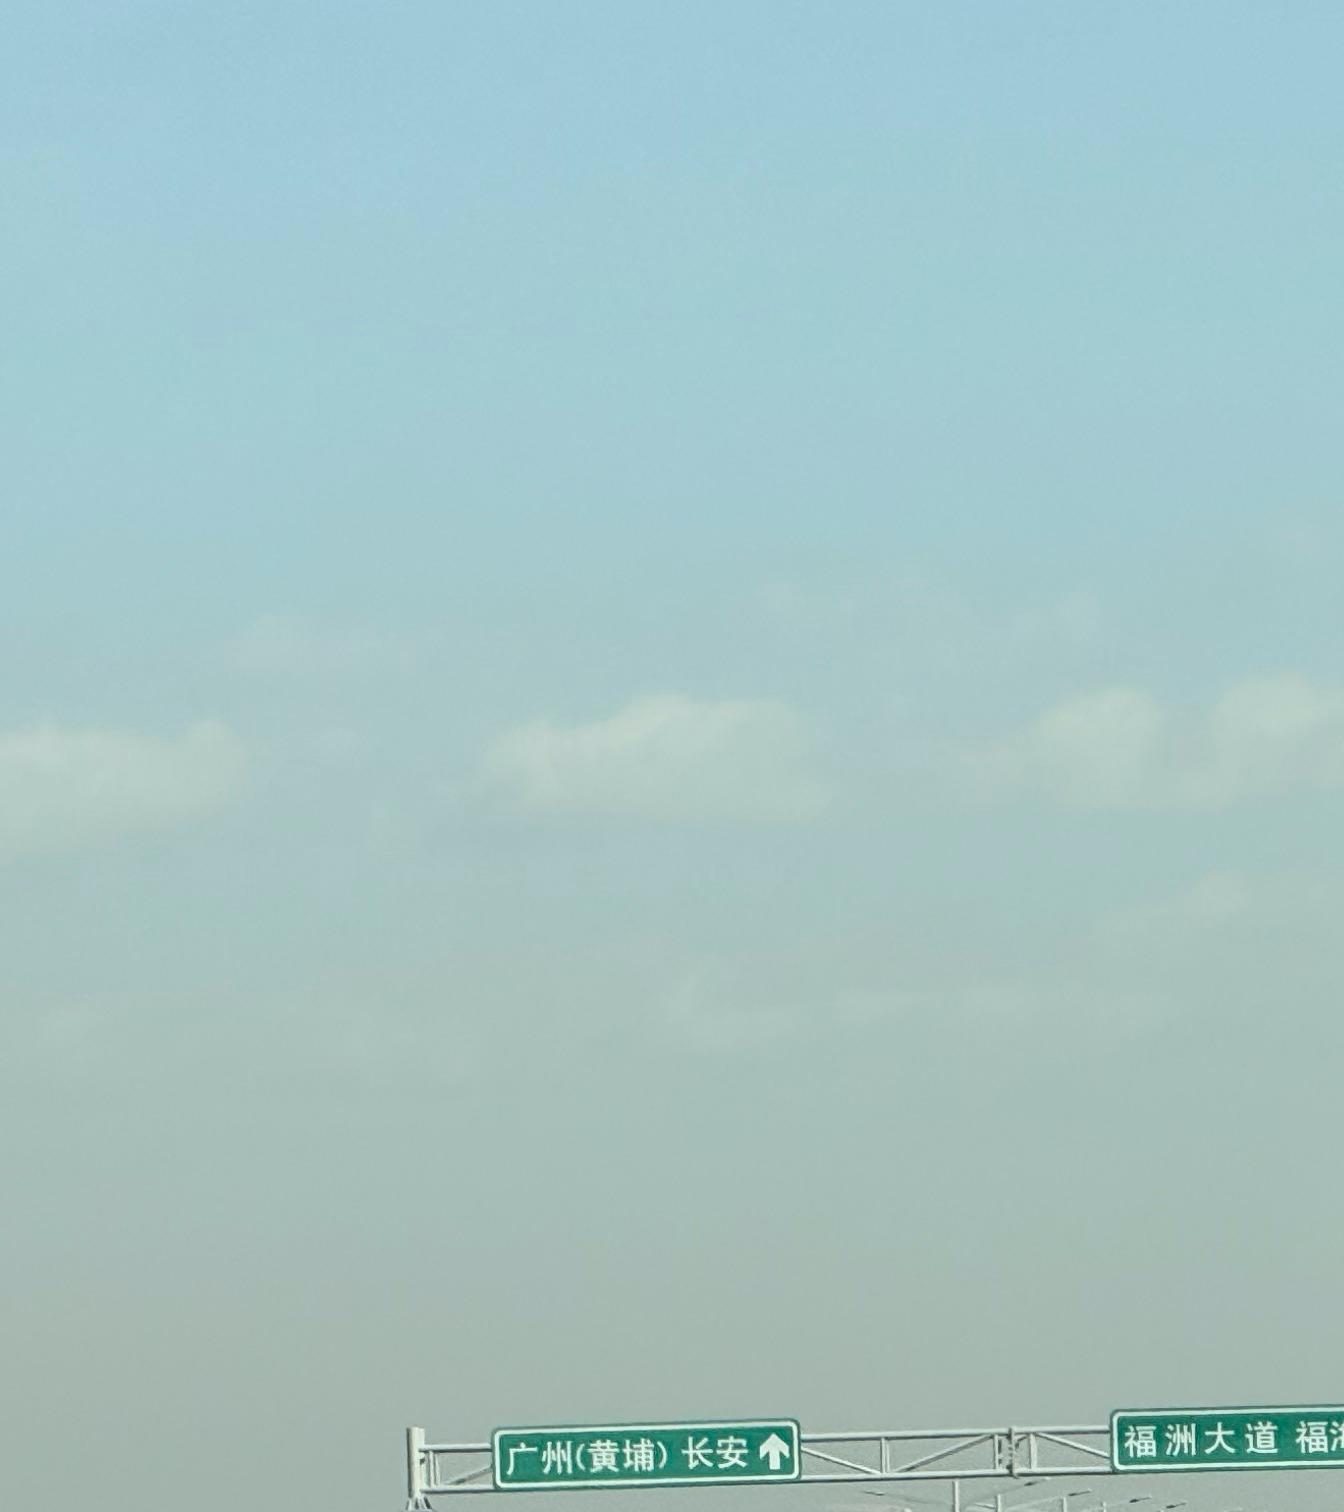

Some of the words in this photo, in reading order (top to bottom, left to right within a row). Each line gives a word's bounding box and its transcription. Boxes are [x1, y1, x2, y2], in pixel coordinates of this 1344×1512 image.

[506, 1439, 668, 1475] 广州(黄埔)
[681, 1436, 749, 1469] 长安
[1124, 1421, 1279, 1458] 福洲大道
